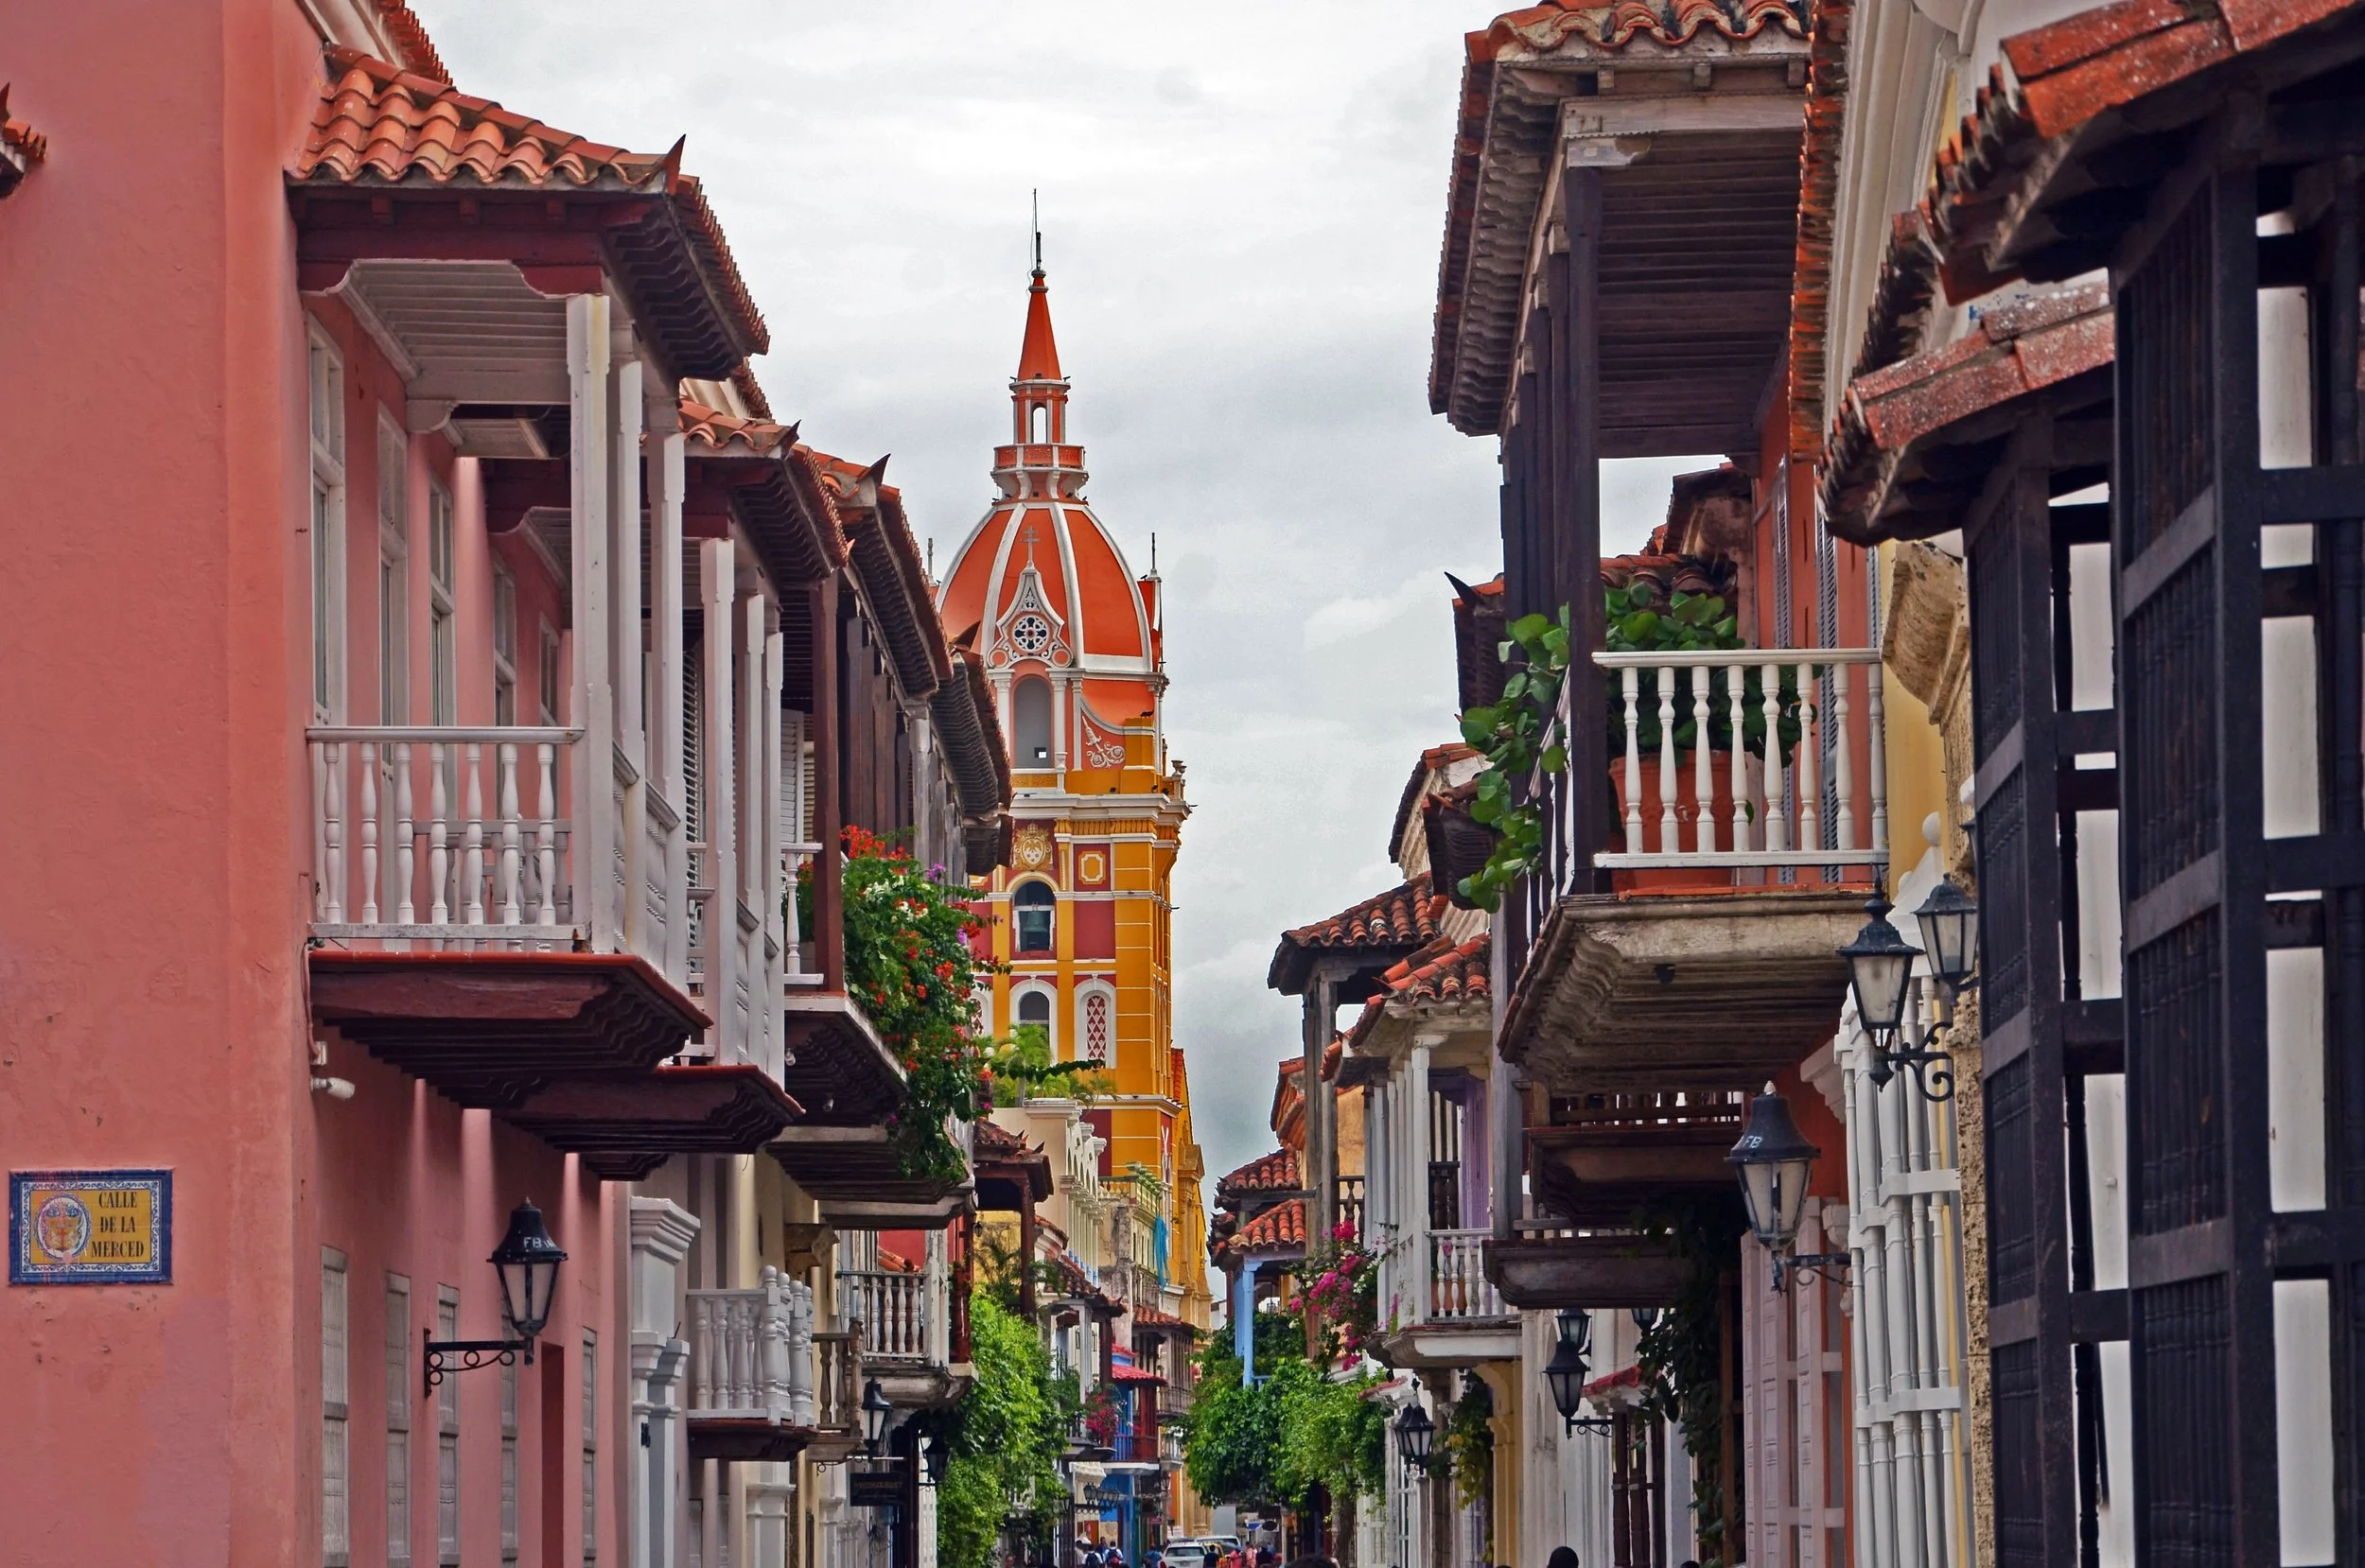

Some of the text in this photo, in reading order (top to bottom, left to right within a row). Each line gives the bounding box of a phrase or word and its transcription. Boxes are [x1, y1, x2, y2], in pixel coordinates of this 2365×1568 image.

[98, 1192, 137, 1209] CALLE
[100, 1216, 135, 1233] DE LA
[92, 1241, 144, 1258] MERCED
